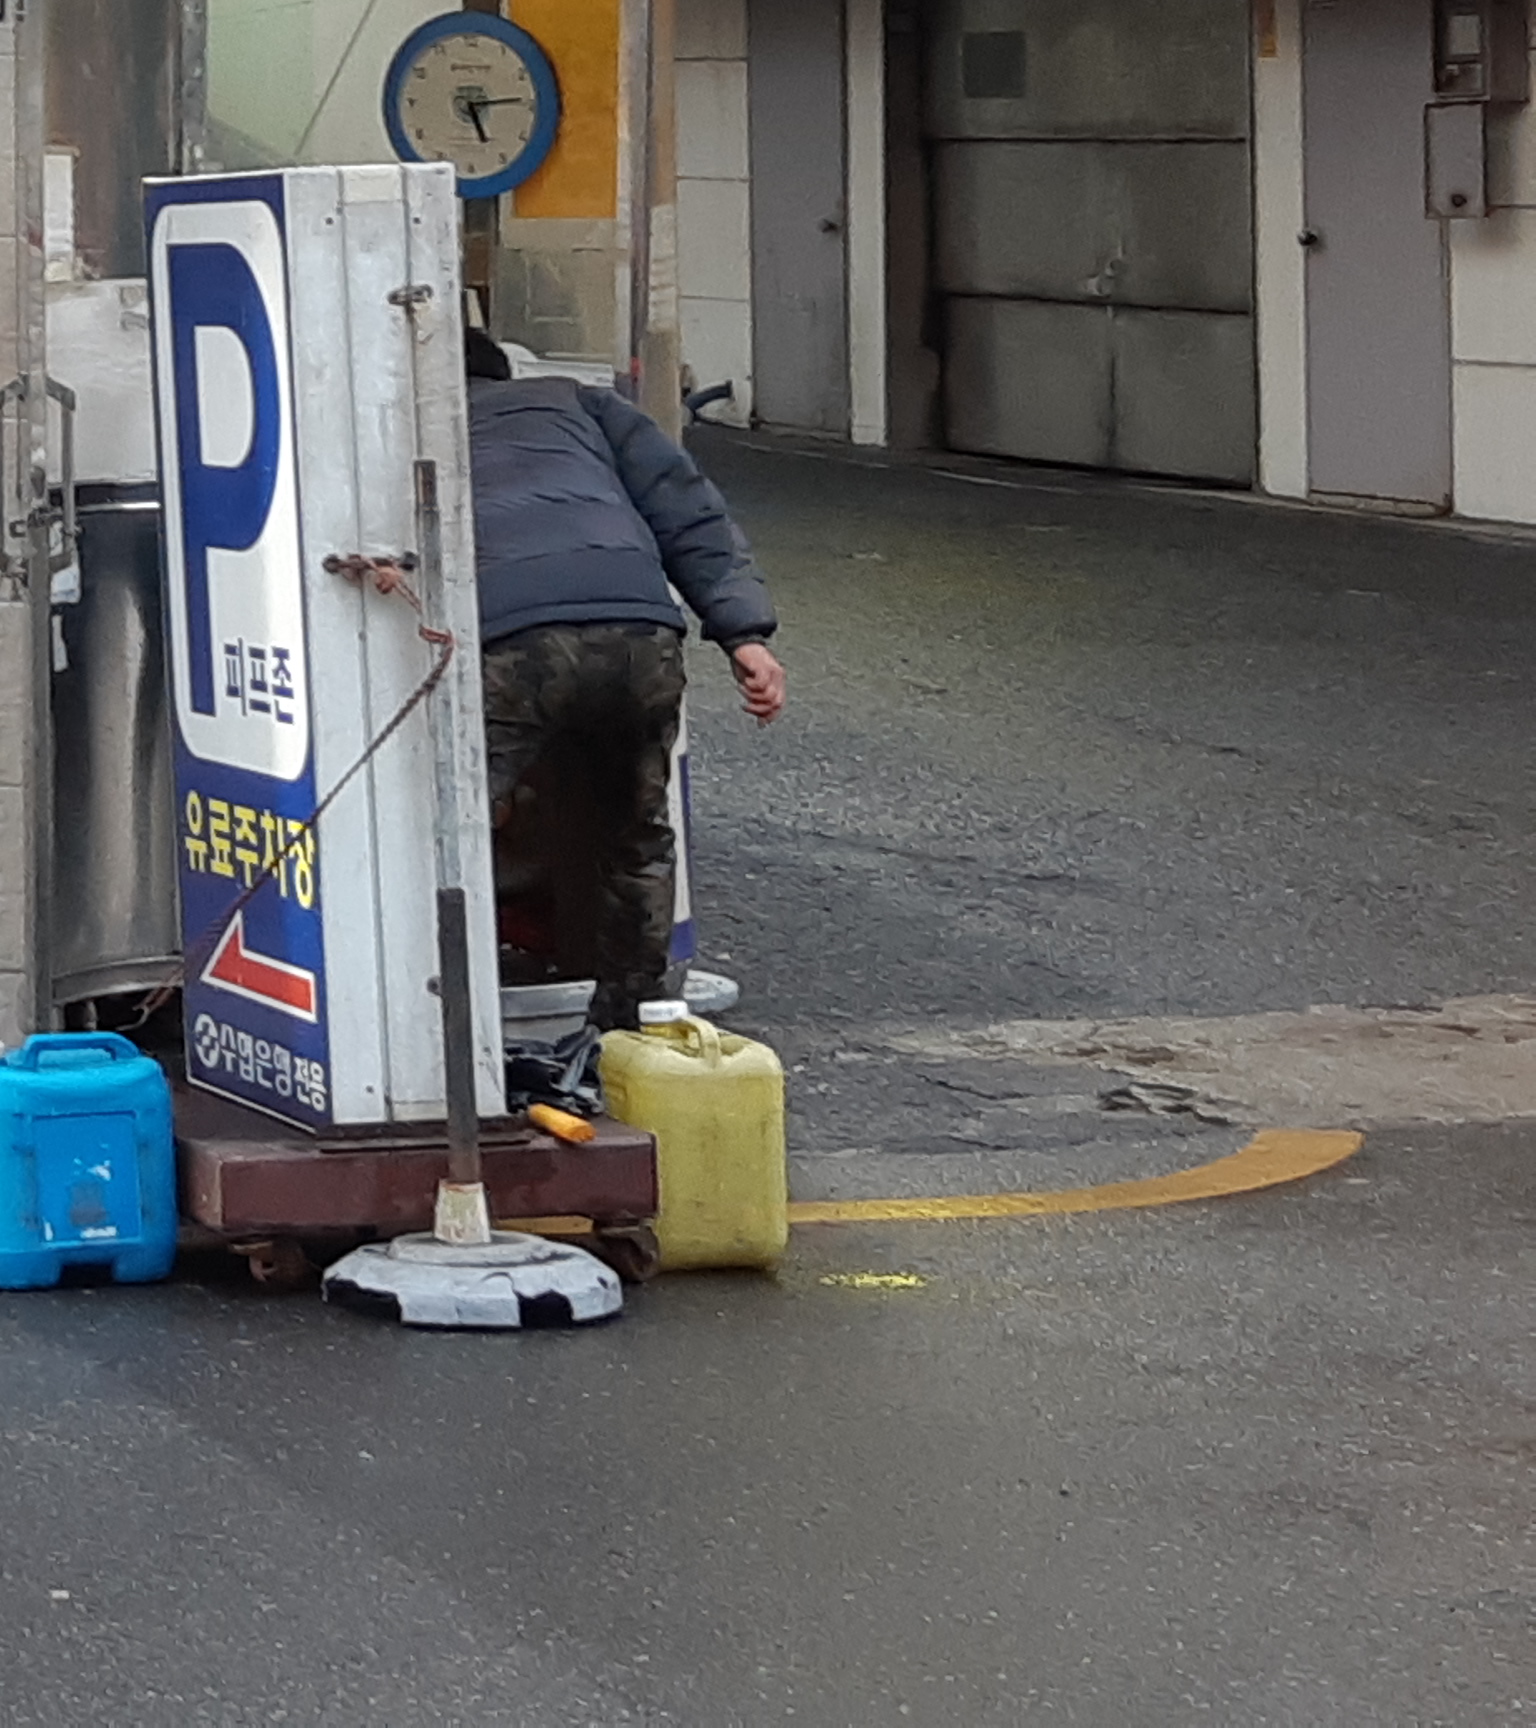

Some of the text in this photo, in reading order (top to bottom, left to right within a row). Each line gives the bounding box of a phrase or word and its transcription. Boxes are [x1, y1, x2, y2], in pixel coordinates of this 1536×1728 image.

[167, 241, 280, 718] P
[223, 636, 296, 725] 피프존
[184, 789, 316, 910] 유료주차장
